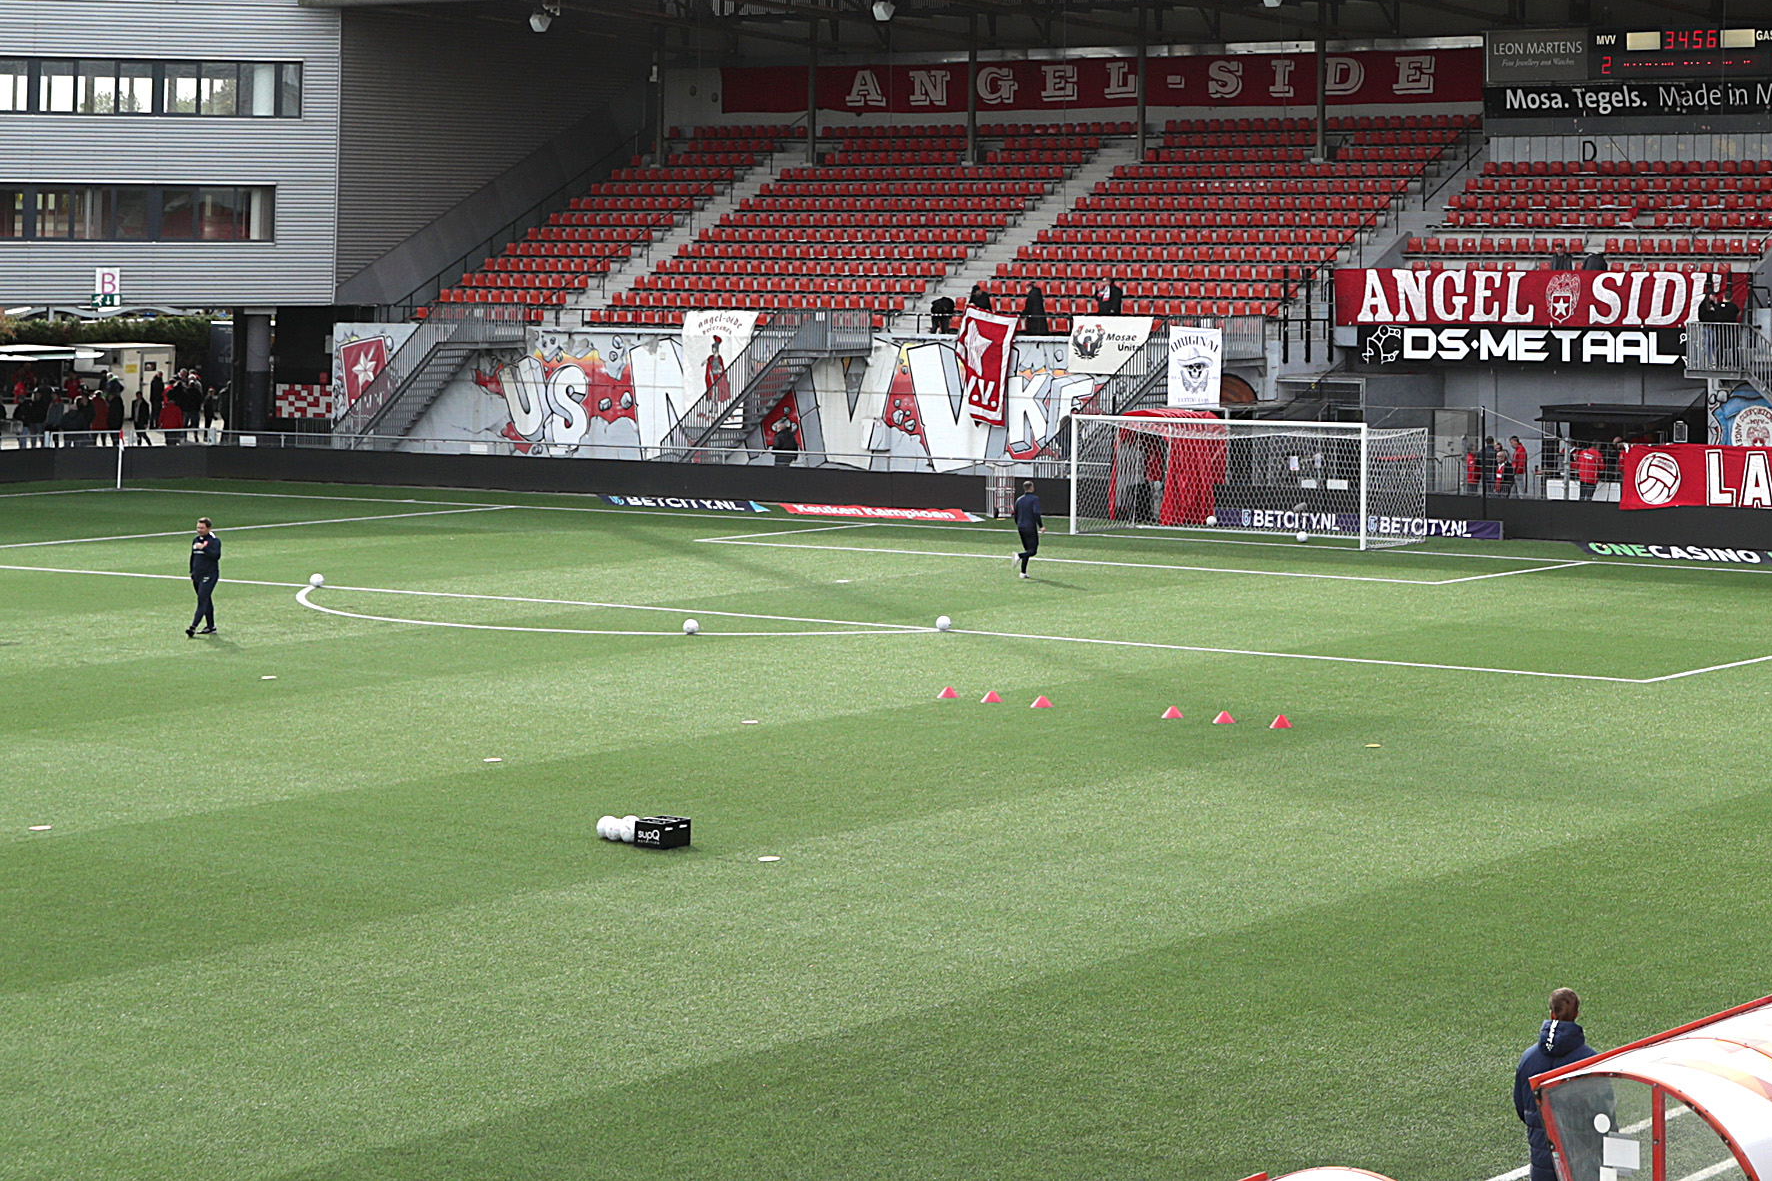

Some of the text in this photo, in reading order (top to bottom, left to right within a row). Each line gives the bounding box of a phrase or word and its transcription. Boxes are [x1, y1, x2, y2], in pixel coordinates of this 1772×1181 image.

[1493, 40, 1583, 55] LEON MARTENS
[1596, 34, 1616, 45] MVV
[1601, 55, 1612, 75] 2
[1506, 88, 1569, 109] Mosa.
[1572, 85, 1647, 114] Tegels.
[1659, 83, 1721, 107] Made
[1728, 82, 1748, 105] in
[101, 272, 117, 294] B
[1357, 269, 1534, 323] ANGEL
[1170, 335, 1219, 353] ORIGINAL
[625, 496, 745, 512] BETCITY.NL
[792, 503, 956, 520] Keuken Kampioen
[1253, 509, 1341, 532] BETCITY.NL
[1379, 516, 1472, 538] BETCITY.NL
[1588, 541, 1762, 565] ONECASINO
[637, 829, 660, 843] supQ
